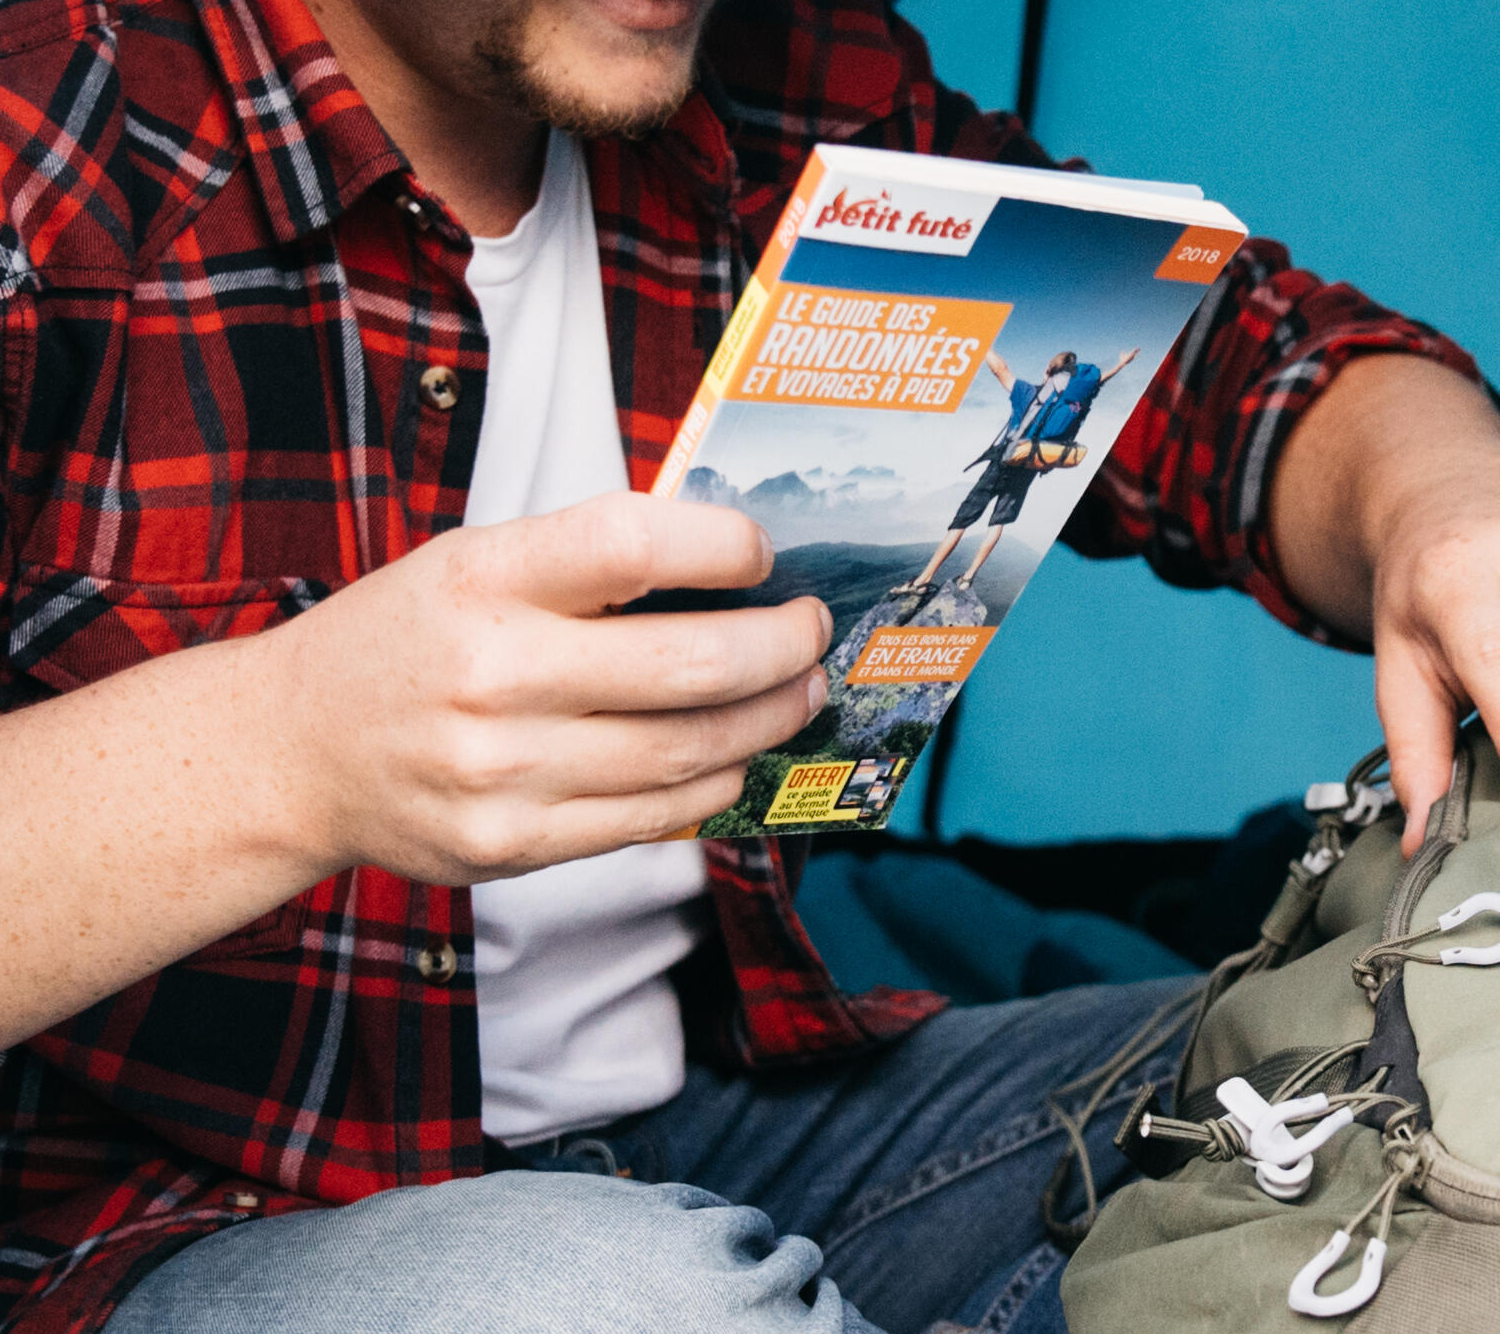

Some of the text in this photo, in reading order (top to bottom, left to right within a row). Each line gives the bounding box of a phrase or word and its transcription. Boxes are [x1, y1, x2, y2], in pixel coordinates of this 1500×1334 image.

[778, 197, 806, 249] 2018
[814, 201, 974, 240] petit futé
[1177, 246, 1221, 264] 2018
[777, 291, 936, 332] LE GUIDE DES
[756, 322, 980, 377] RANDONNÉES
[741, 365, 955, 405] ET VOYAGES À PIED
[877, 633, 979, 646] TOUS LES BONS PLANS
[865, 646, 970, 665] EN FRANCE
[858, 665, 959, 677] ET DANS LE MONDE
[787, 765, 852, 788] OFFERT
[787, 788, 833, 800] ce guide
[794, 799, 830, 810] format
[769, 809, 830, 820] numérique
